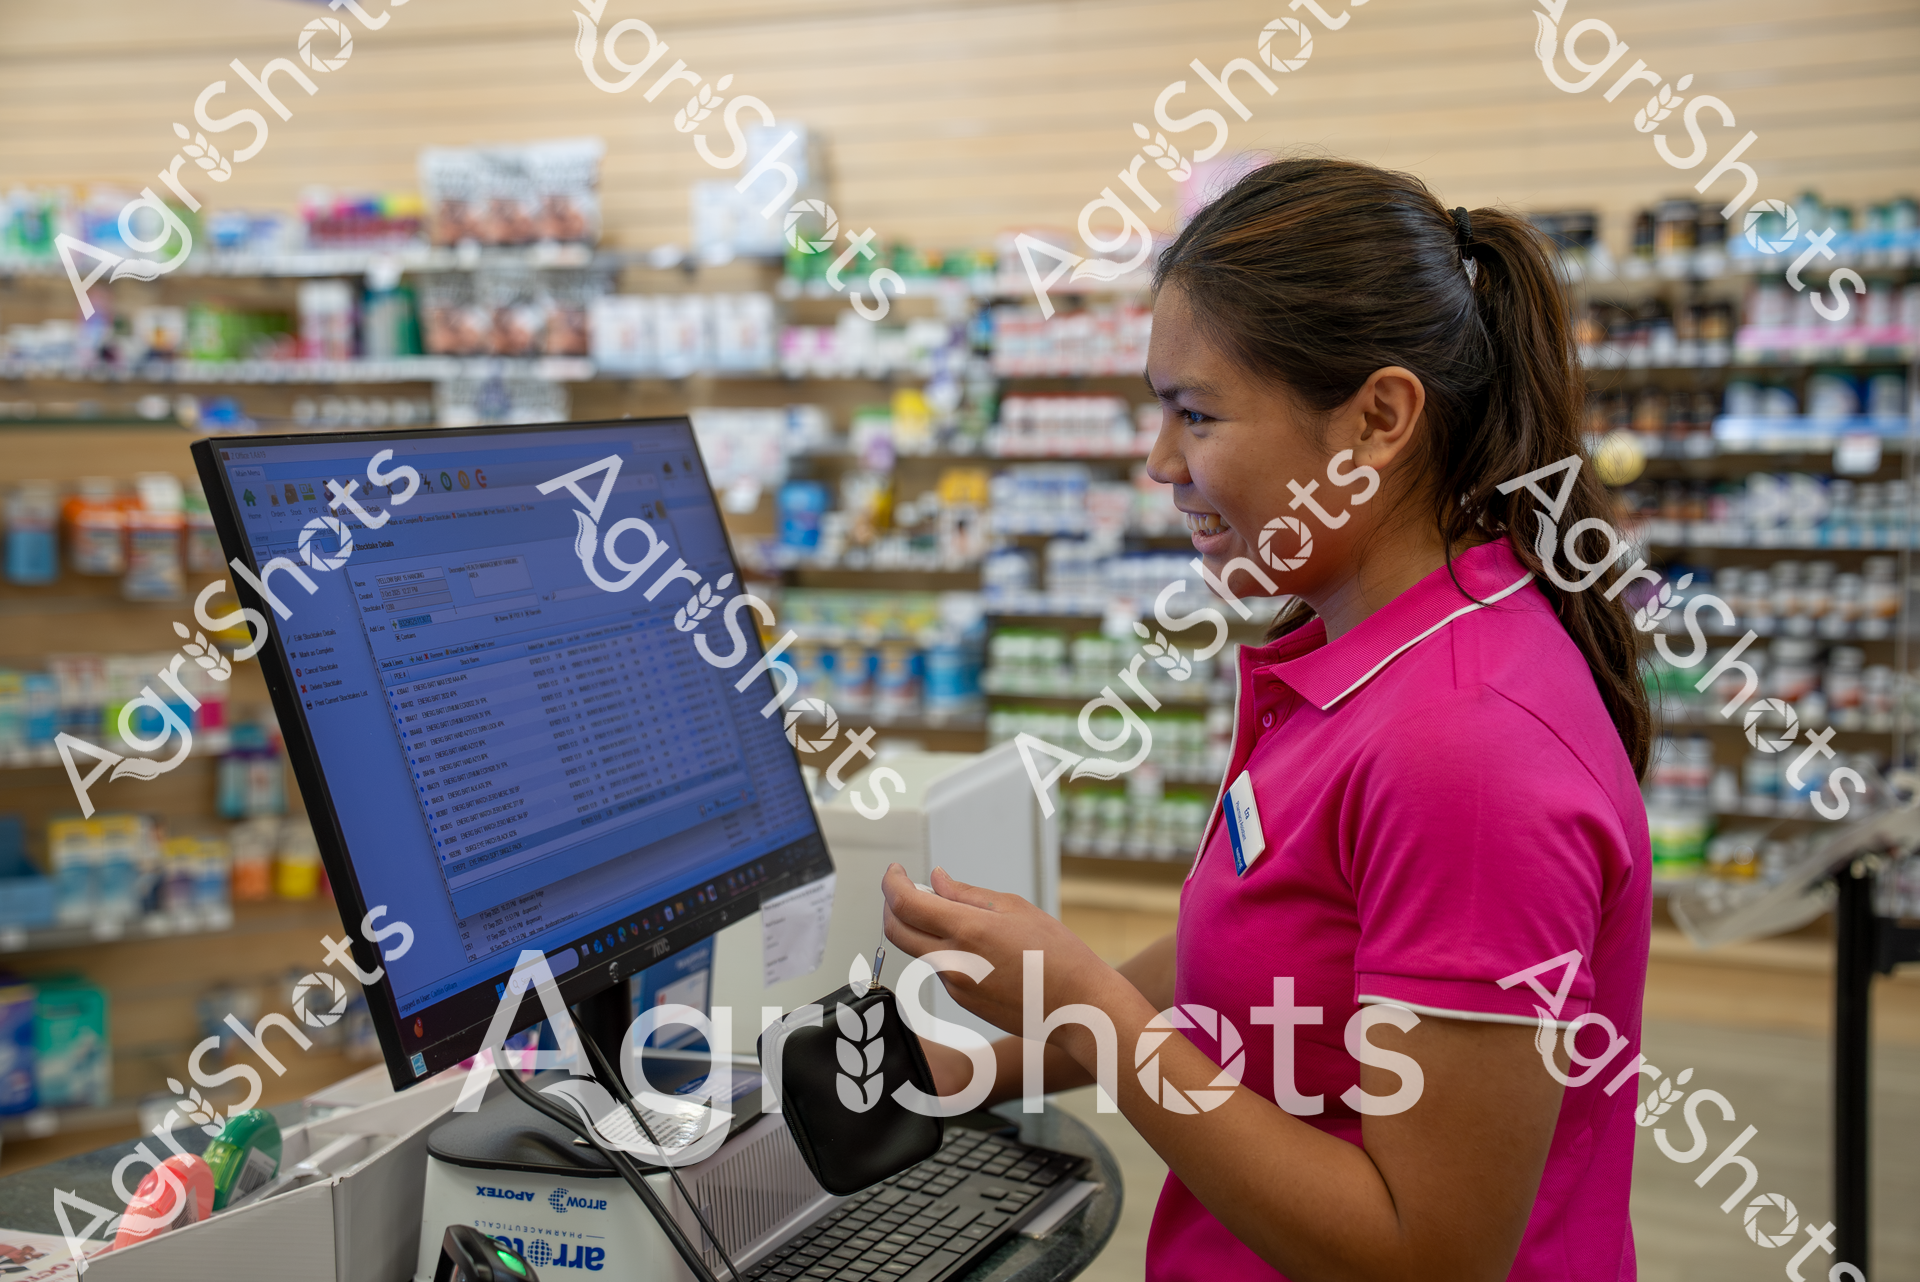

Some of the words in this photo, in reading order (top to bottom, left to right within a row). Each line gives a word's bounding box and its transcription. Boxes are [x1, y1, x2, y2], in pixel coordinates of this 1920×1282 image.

[234, 451, 250, 459] Office
[234, 469, 247, 477] Main
[246, 468, 260, 476] Menu
[247, 511, 262, 519] Home
[270, 509, 286, 517] Orders
[355, 541, 378, 550] Stocktake
[377, 539, 394, 547] Details
[376, 576, 394, 584] YELLOW
[358, 592, 373, 600] Created
[362, 604, 381, 612] Stocktake
[293, 633, 303, 641] Edit
[302, 630, 322, 640] Stocktake
[321, 628, 336, 636] Details
[400, 632, 416, 640] Contains
[298, 650, 310, 658] Mark
[309, 649, 316, 657] as
[314, 646, 334, 656] Complete
[429, 650, 443, 658] Remove
[303, 665, 319, 674] Cancel
[318, 662, 339, 672] Stocktake
[380, 660, 392, 668] Stock
[392, 658, 403, 666] Lines
[309, 682, 323, 690] Delete
[322, 678, 342, 688] Stocktake
[314, 698, 325, 706] Print
[323, 695, 339, 704] Current
[338, 690, 361, 701] Stocktakes
[359, 689, 368, 697] List
[491, 805, 502, 814] ZERO
[475, 840, 485, 849] EYE
[484, 836, 497, 846] PATCH
[496, 832, 509, 842] BLACK
[468, 857, 478, 866] EYE
[476, 853, 490, 864] PATCH
[488, 850, 499, 859] SOFT
[498, 845, 513, 856] SINGLE
[483, 909, 492, 919] Sep
[487, 920, 495, 930] Sep
[490, 931, 499, 941] Sep
[493, 941, 502, 950] Sep
[475, 1185, 536, 1202] APOTEX
[566, 1196, 607, 1211] arrow
[474, 1219, 583, 1240] PHARMACEUTICALS
